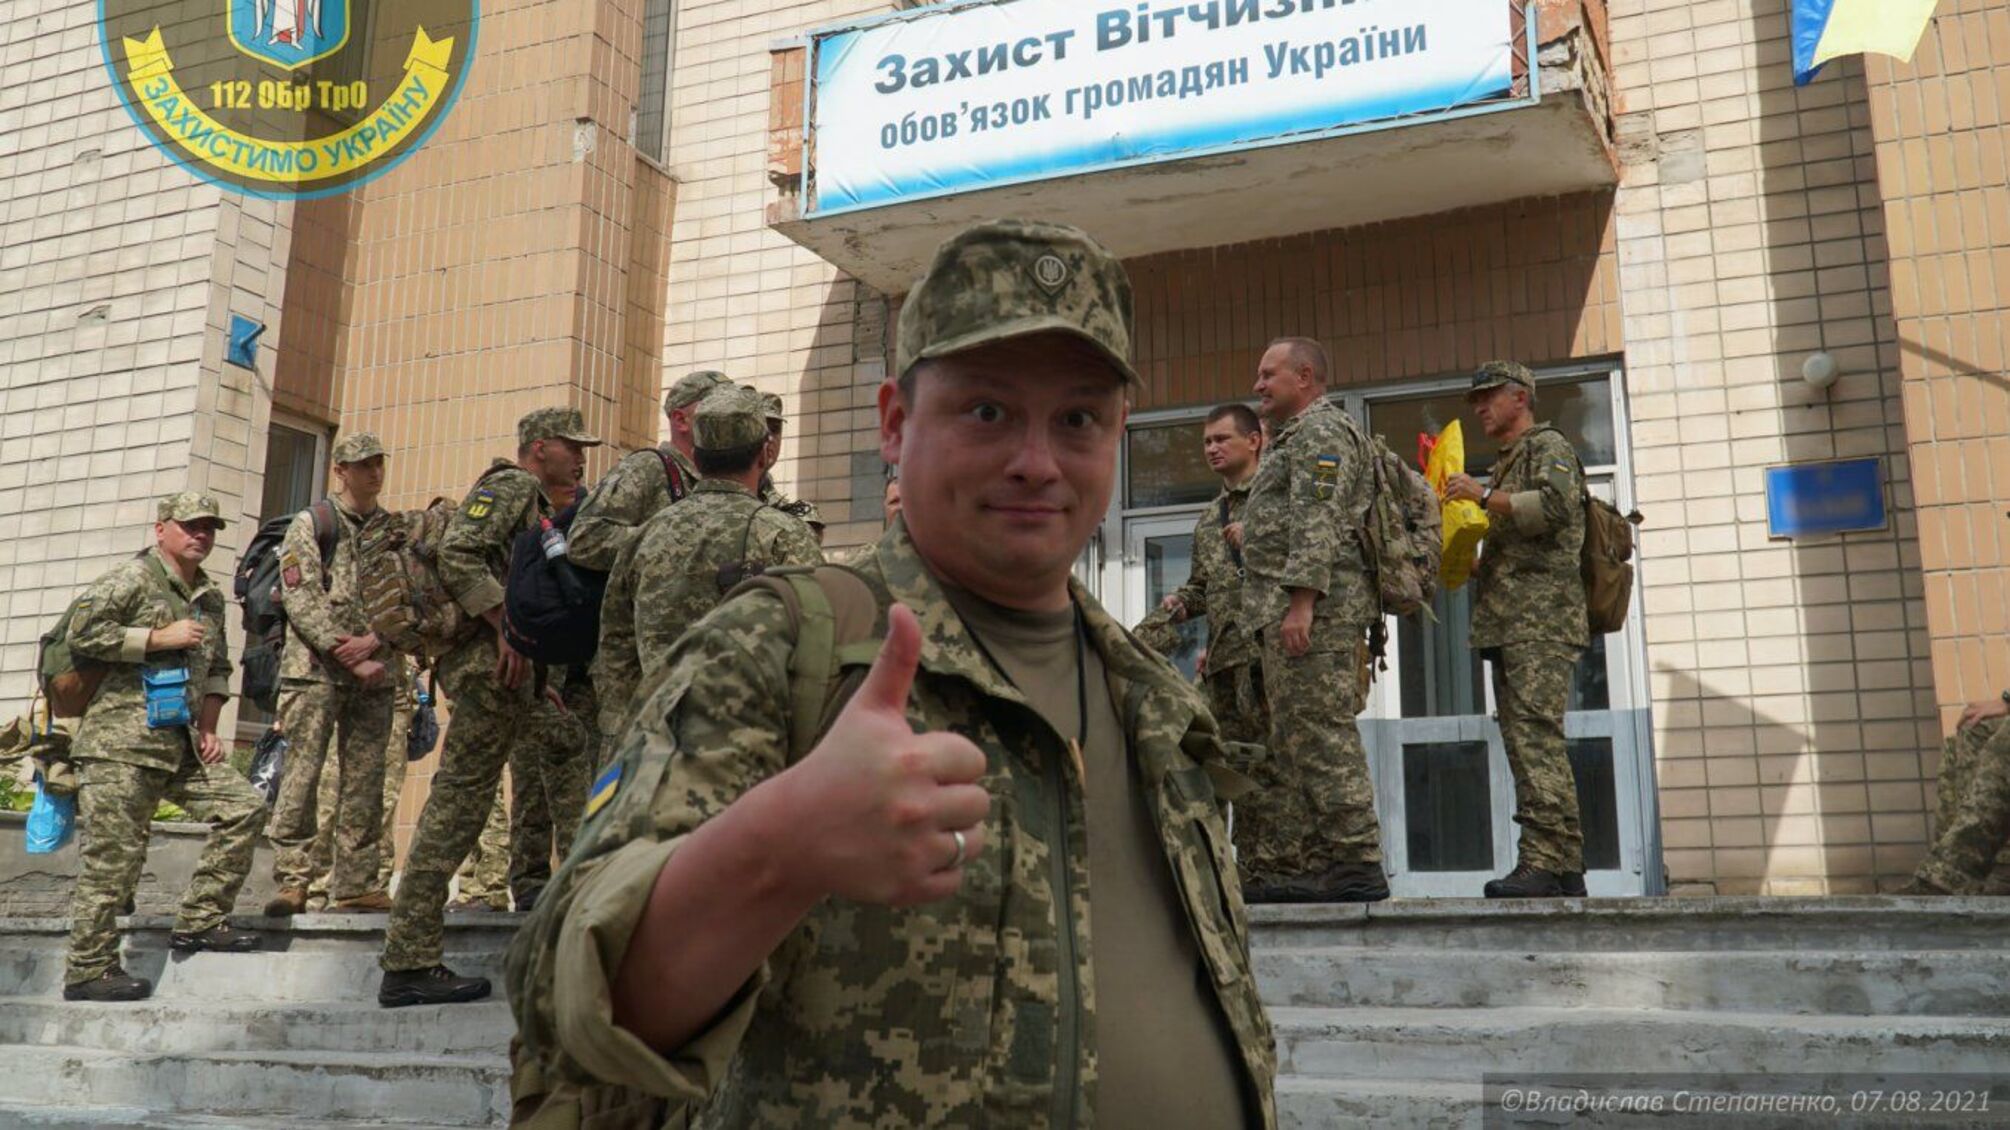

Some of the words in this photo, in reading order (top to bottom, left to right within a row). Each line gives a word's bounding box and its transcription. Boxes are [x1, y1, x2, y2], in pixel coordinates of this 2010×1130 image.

[874, 29, 1075, 95] Захист
[1096, 0, 1371, 52] Вітчиз
[1065, 56, 1250, 120] громадян
[1263, 23, 1428, 80] України
